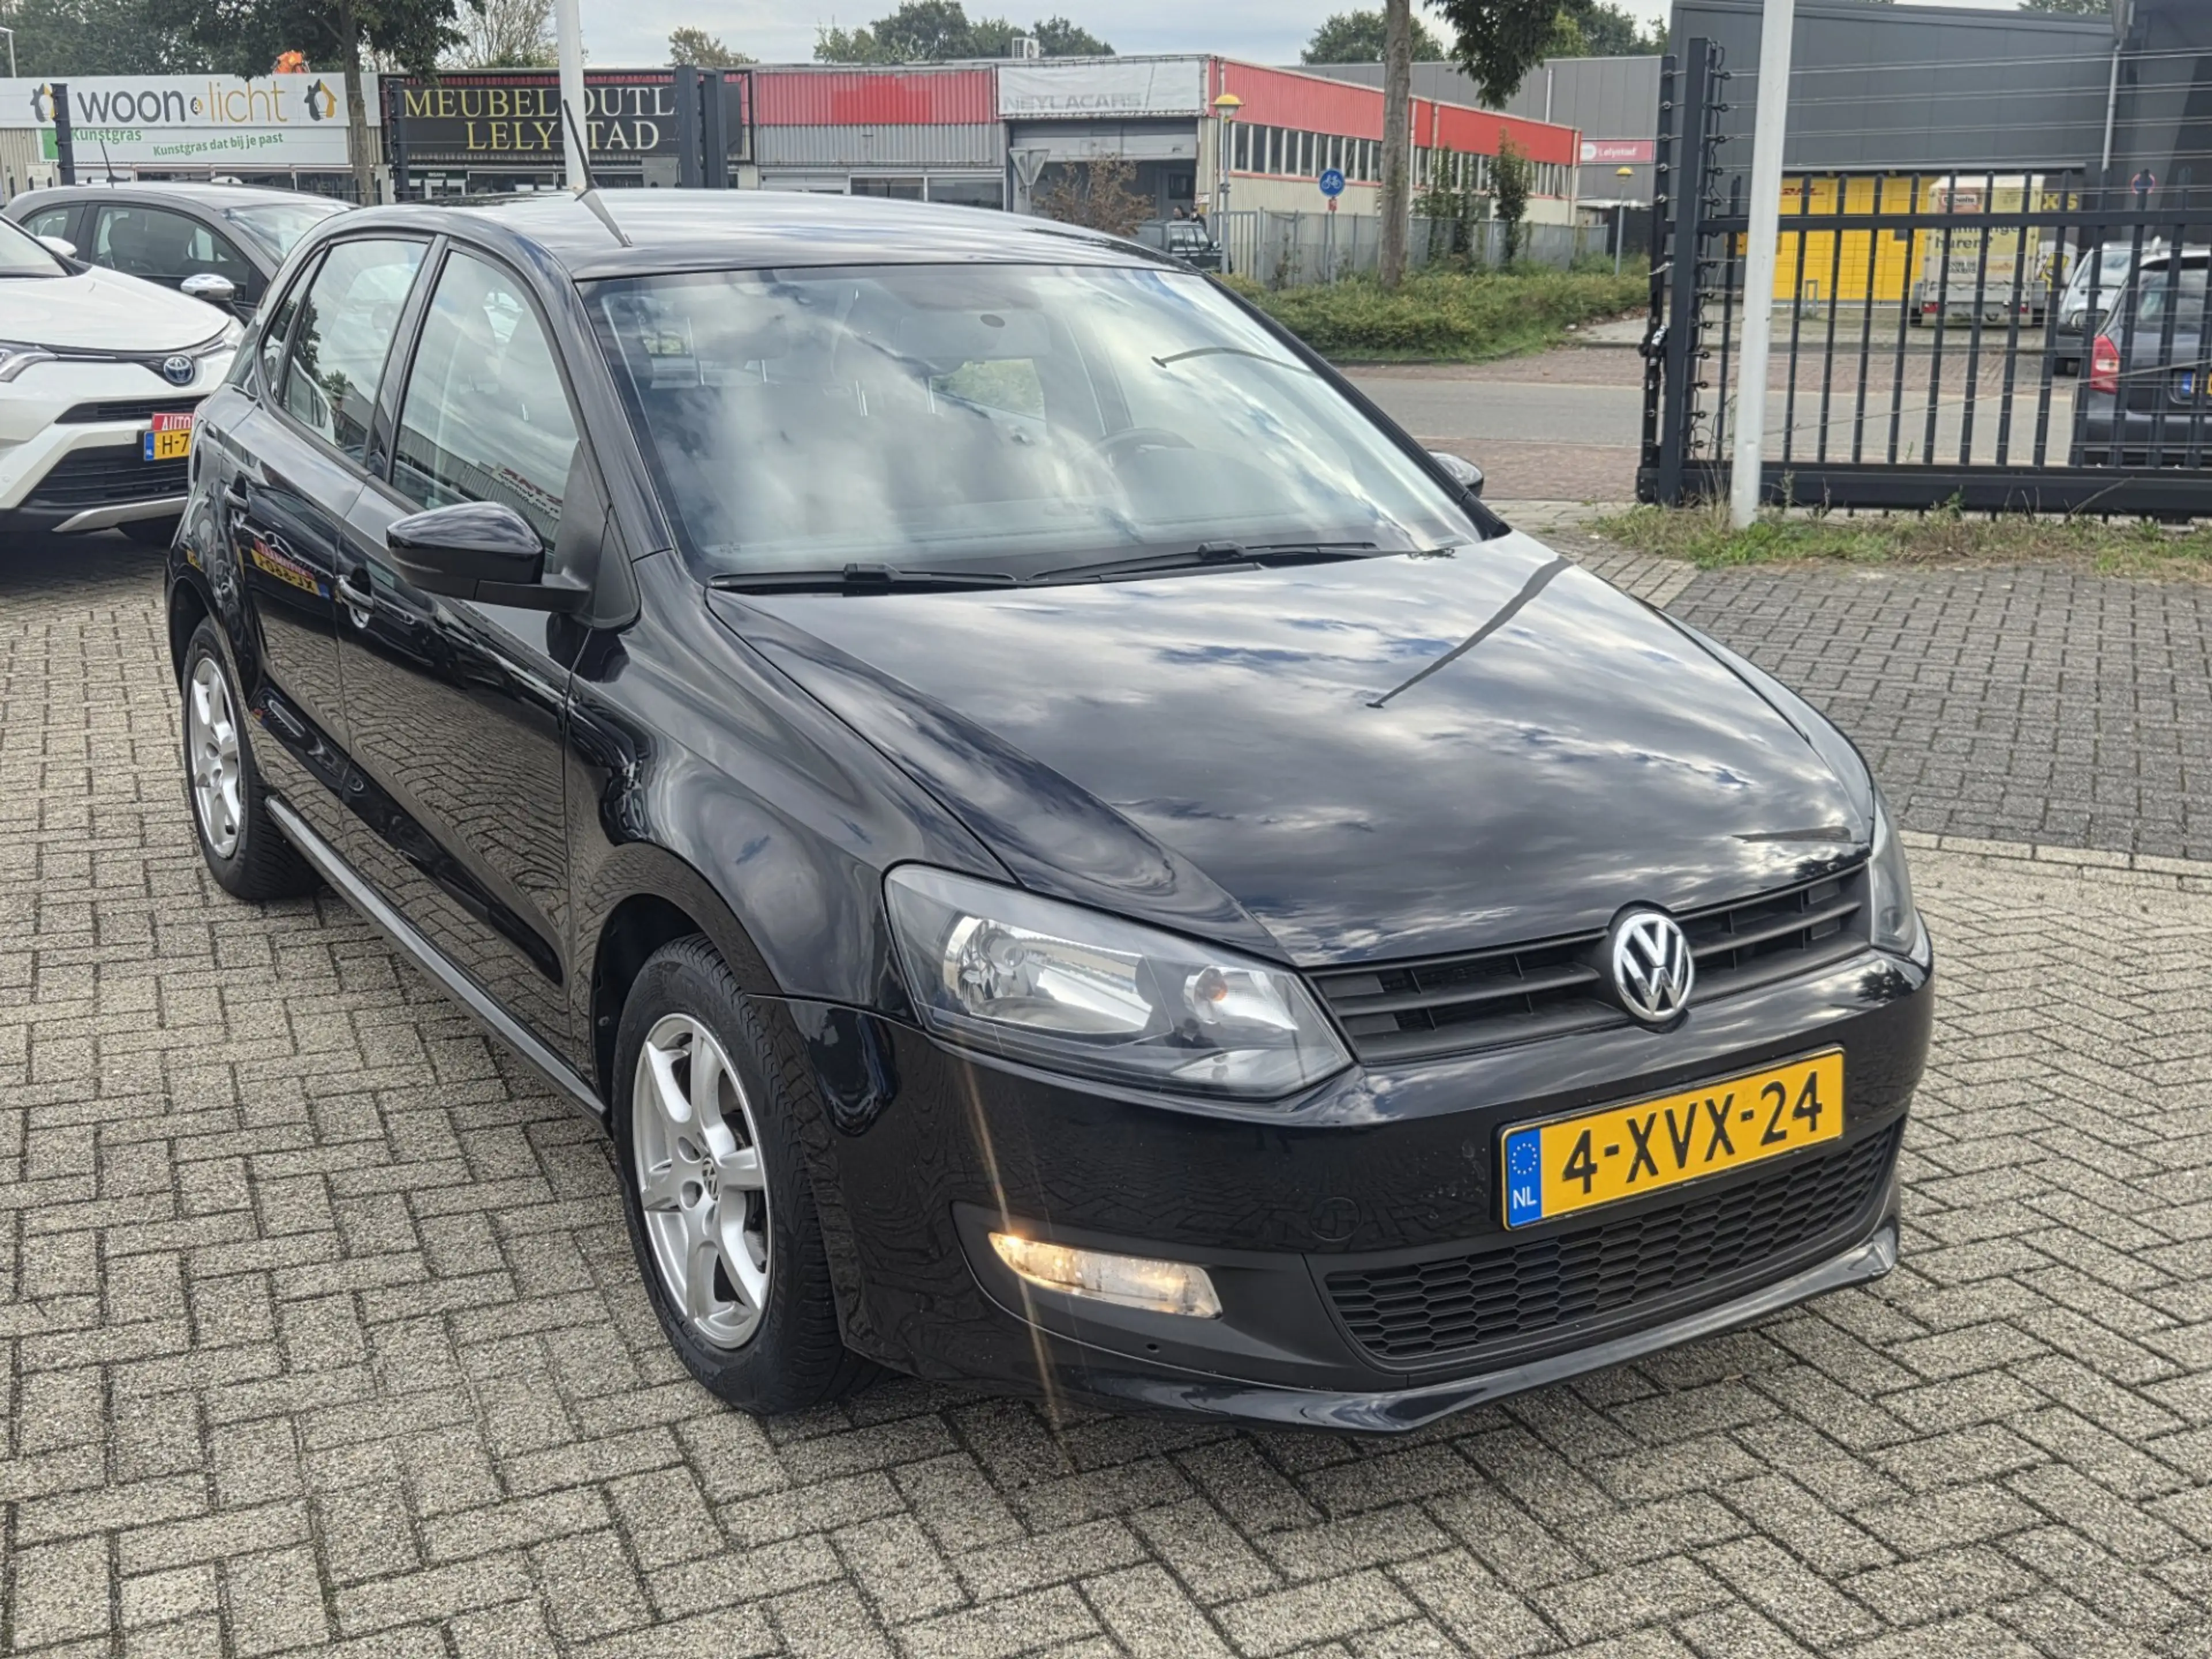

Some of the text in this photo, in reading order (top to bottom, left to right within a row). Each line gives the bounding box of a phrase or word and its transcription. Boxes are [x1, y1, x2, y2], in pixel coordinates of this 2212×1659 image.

[77, 90, 186, 123] woon
[208, 81, 287, 123] licht
[403, 88, 558, 118] MEUBEL
[71, 127, 142, 145] Kunstgras
[153, 132, 283, 156] Kunstgras dat bij je past
[465, 119, 659, 150] LELYTAD
[162, 433, 190, 455] H-7
[1562, 1070, 1823, 1194] 4-XVX-24
[1512, 1185, 1537, 1210] NL
